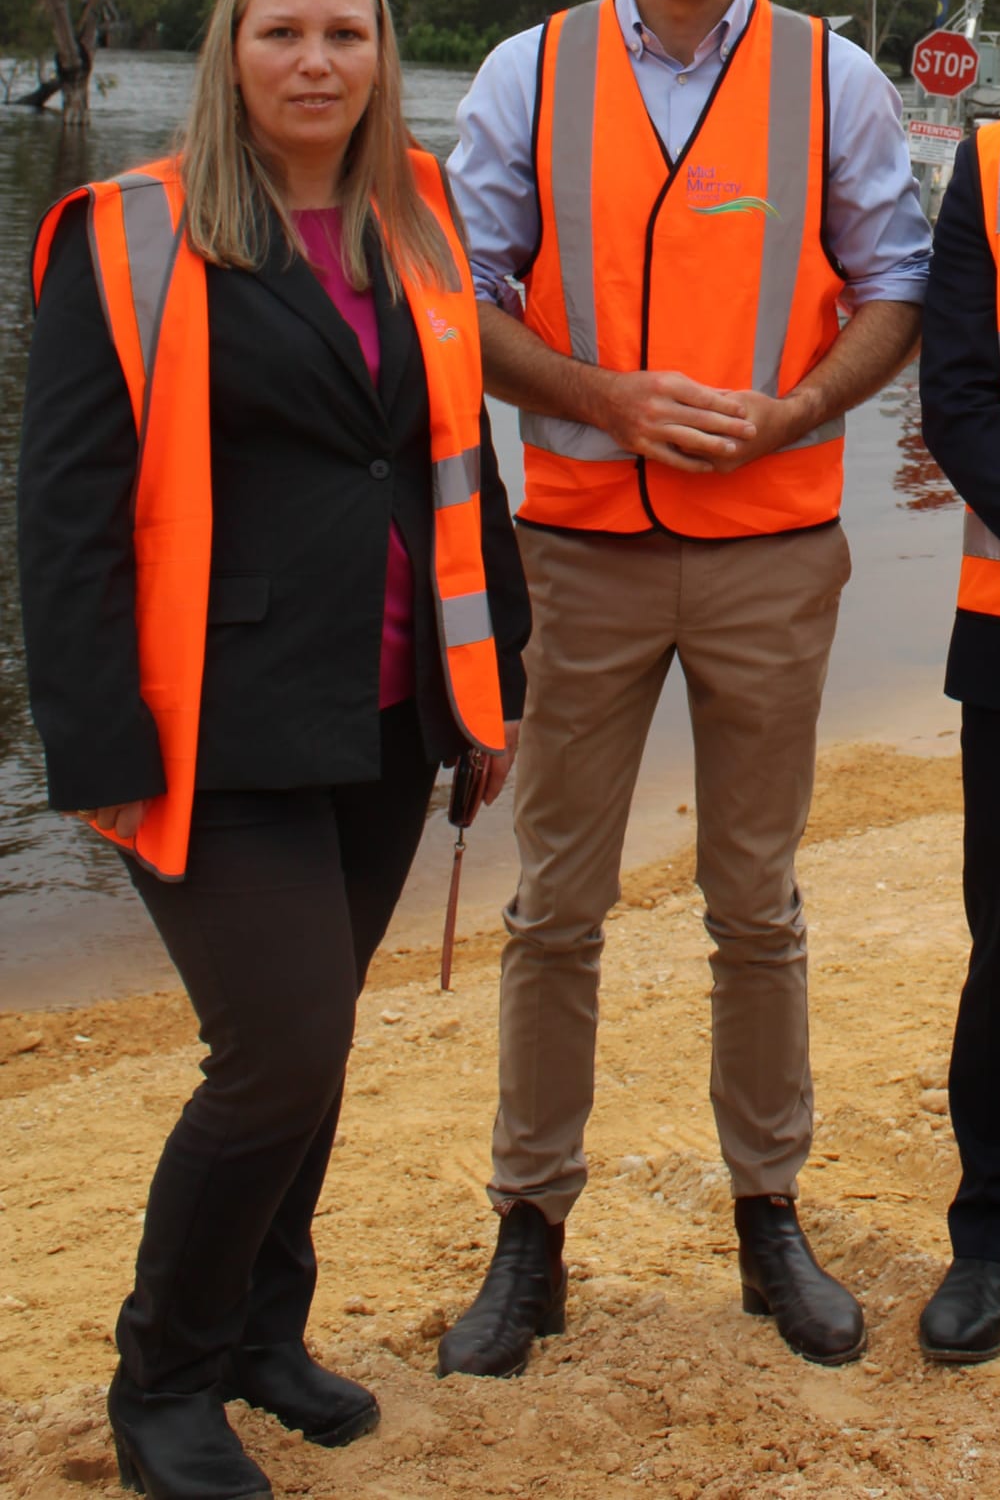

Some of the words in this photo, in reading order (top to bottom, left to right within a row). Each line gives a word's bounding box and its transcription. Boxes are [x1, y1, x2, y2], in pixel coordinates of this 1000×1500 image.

[916, 48, 975, 79] STOP
[911, 123, 960, 138] ATTENTION
[687, 165, 716, 179] Mid
[687, 179, 742, 196] Murray
